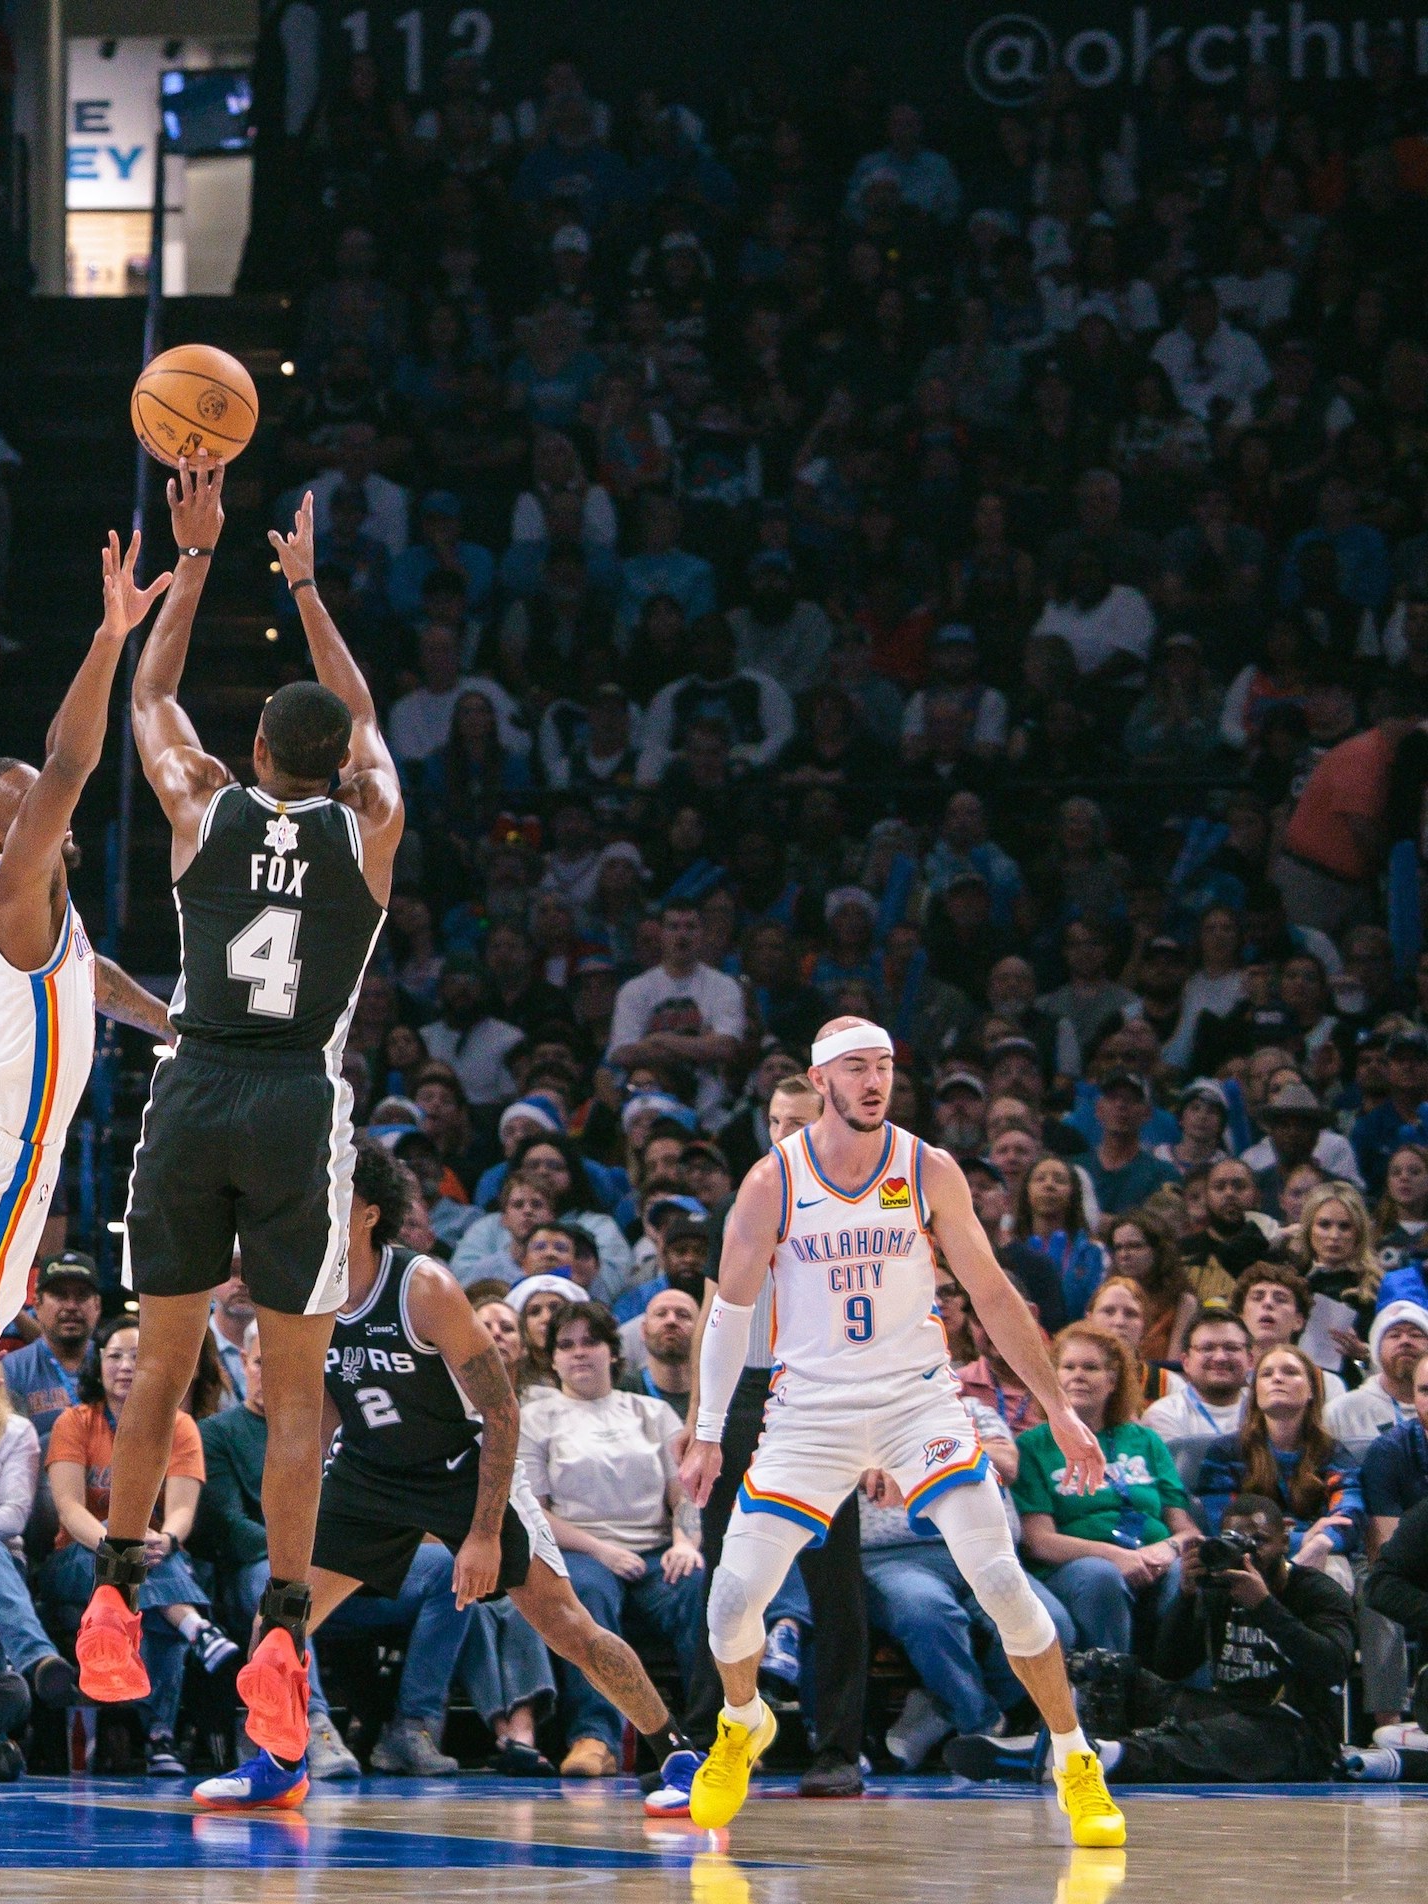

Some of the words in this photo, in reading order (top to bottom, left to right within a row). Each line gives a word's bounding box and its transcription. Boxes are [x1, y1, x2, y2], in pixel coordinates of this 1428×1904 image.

[965, 0, 1428, 107] @okcthu
[250, 853, 309, 898] FOX
[226, 905, 302, 1019] 4
[789, 1227, 917, 1263] OKLAHOMA
[828, 1261, 884, 1293] CITY
[843, 1293, 876, 1345] 9
[354, 1386, 402, 1429] 2
